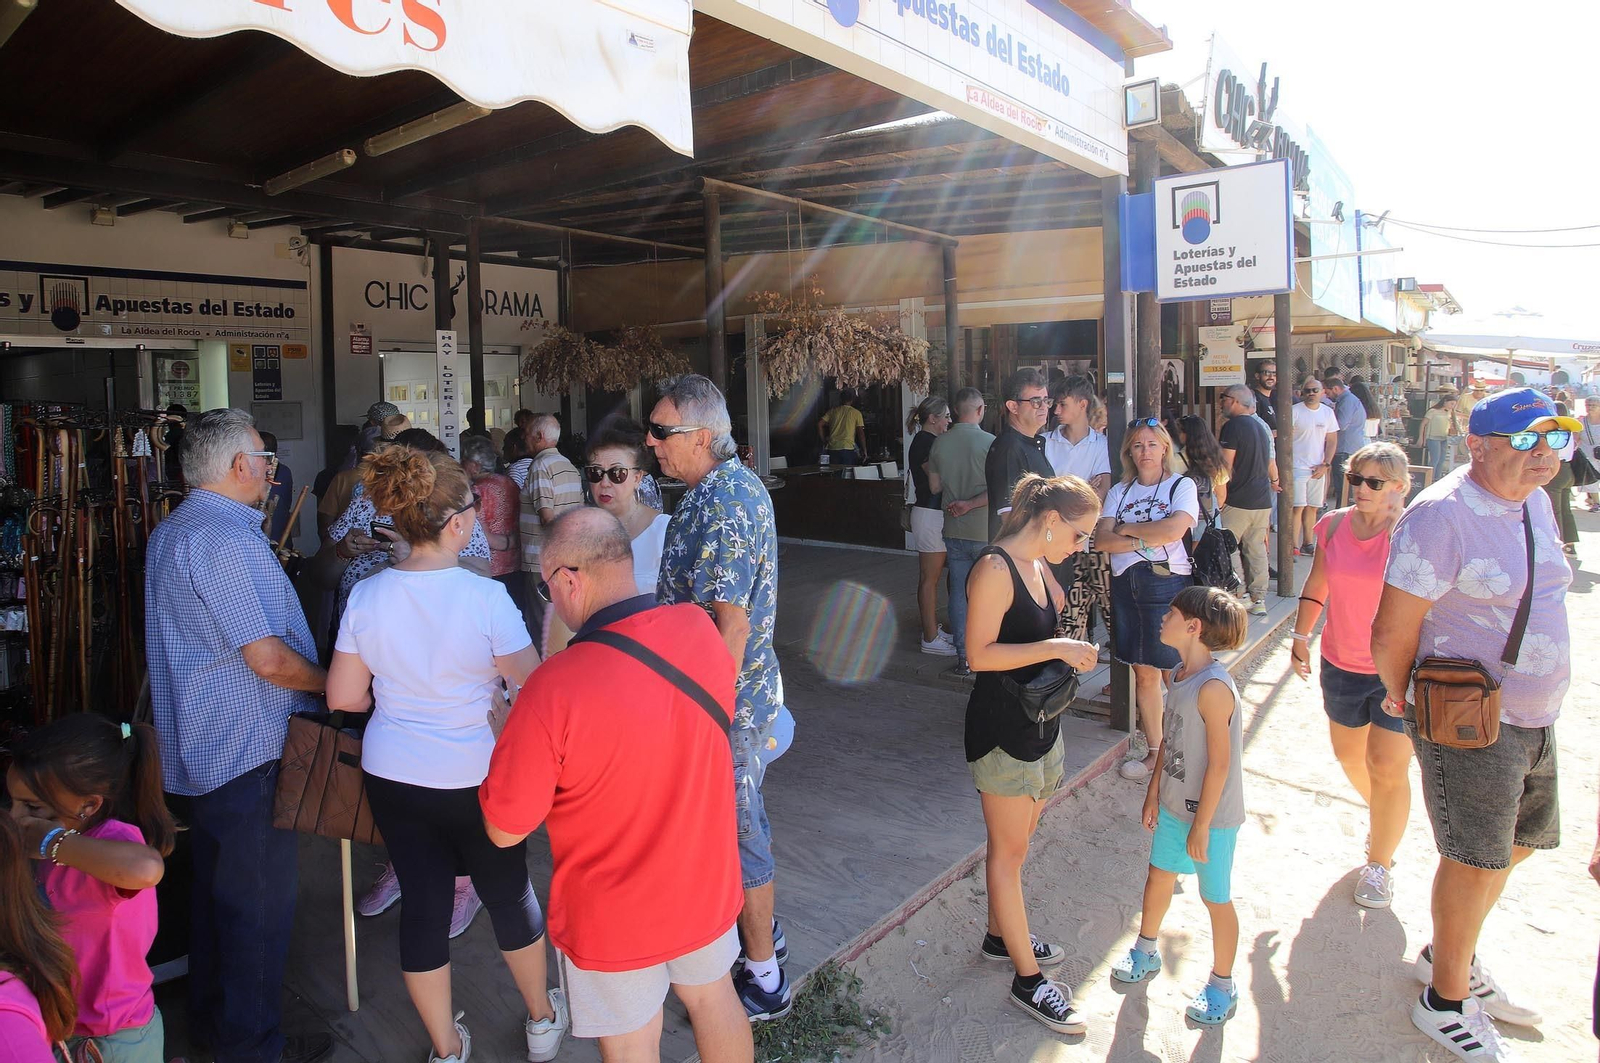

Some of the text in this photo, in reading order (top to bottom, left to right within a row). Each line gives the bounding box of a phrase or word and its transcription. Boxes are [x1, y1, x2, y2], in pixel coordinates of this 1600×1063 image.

[894, 0, 1070, 97] puestas del Estado
[968, 88, 979, 103] La
[981, 94, 1005, 114] Aldea
[1007, 104, 1019, 119] del
[1054, 124, 1099, 156] Administración
[1173, 246, 1236, 260] Loterías y
[1174, 256, 1257, 276] Apuestas del
[1173, 275, 1217, 288] Estado
[18, 293, 34, 313] y
[95, 294, 197, 317] Apuestas
[199, 299, 228, 316] del
[233, 301, 295, 320] Estado
[364, 280, 544, 318] CHIC RAMA
[121, 327, 132, 335] La
[134, 327, 160, 336] Aldea
[161, 328, 176, 336] del
[214, 329, 275, 339] Administración
[442, 335, 452, 355] HAY
[445, 425, 455, 438] DE
